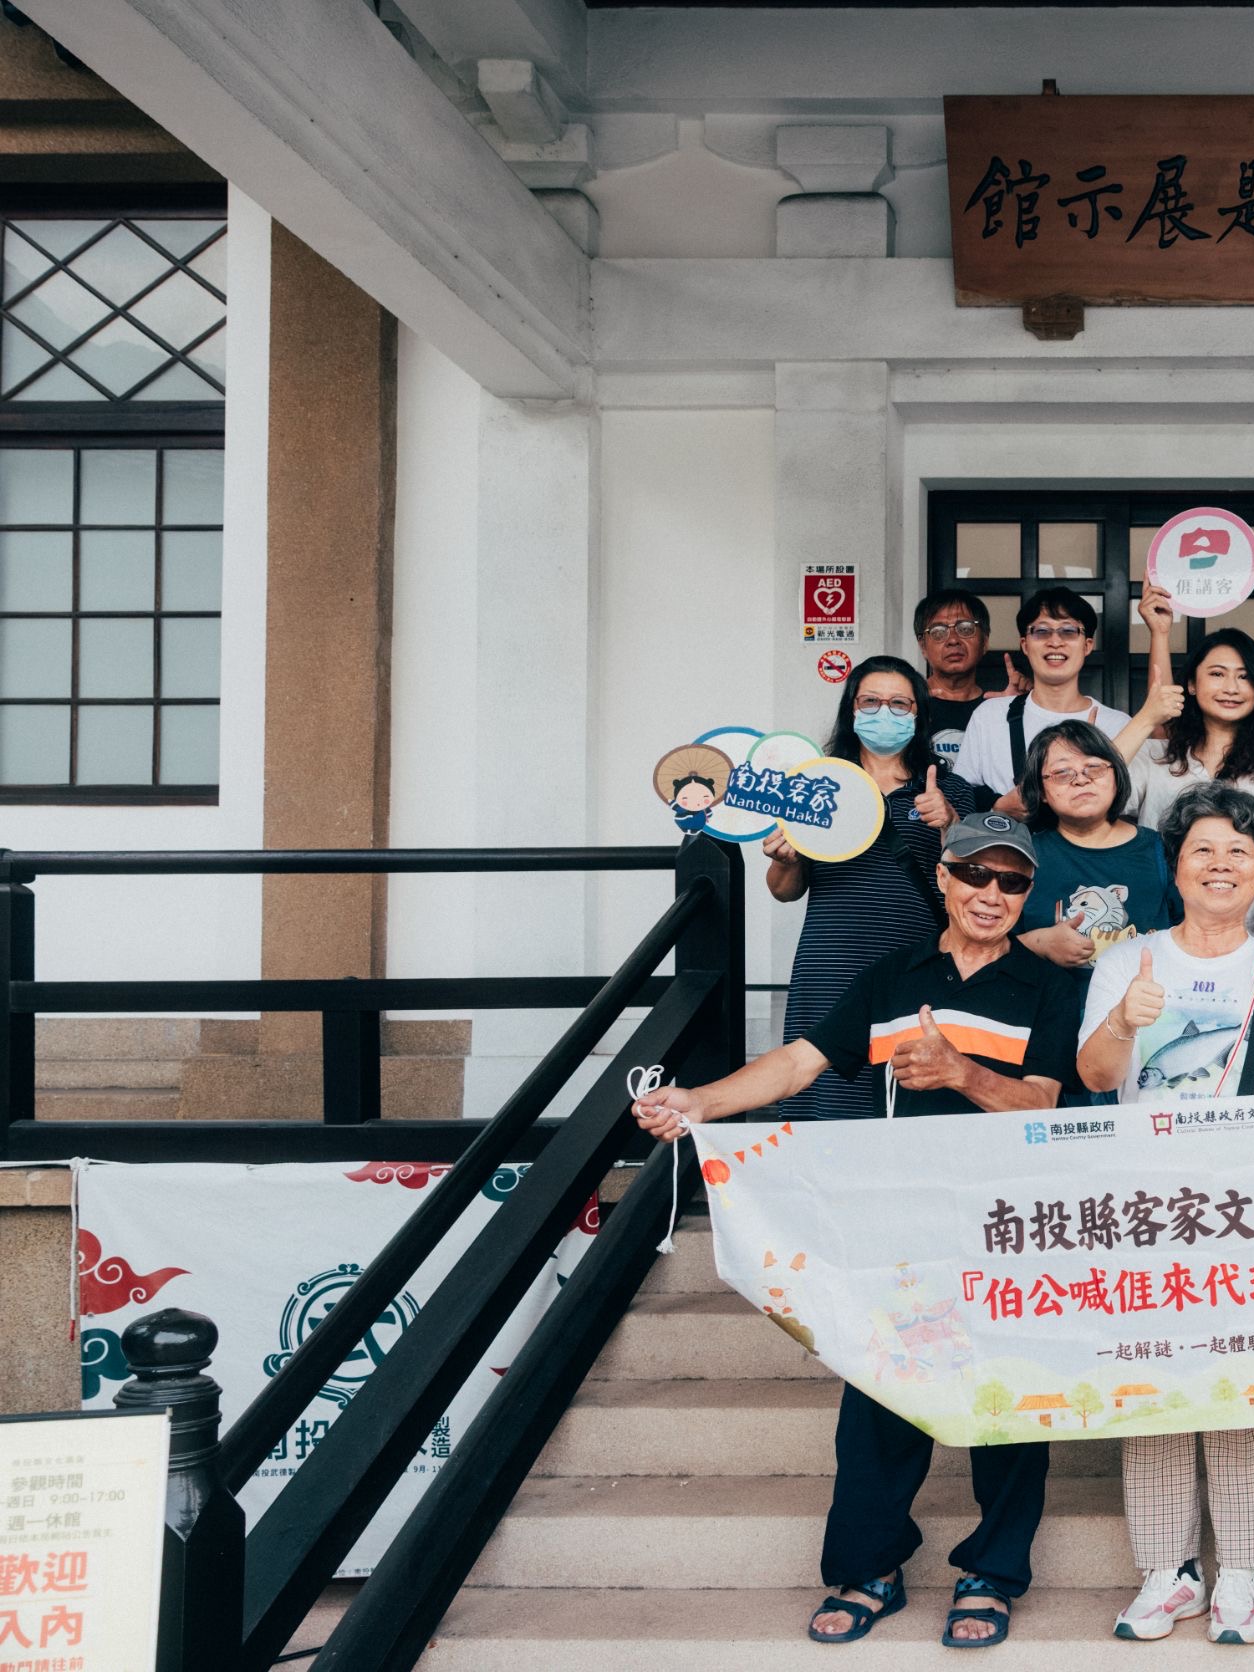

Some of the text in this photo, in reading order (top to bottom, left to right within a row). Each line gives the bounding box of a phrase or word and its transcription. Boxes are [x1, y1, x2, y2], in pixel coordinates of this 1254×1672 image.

[818, 578, 842, 588] AED
[935, 743, 961, 753] LUC
[728, 762, 838, 812] 南投客家
[725, 792, 830, 827] Nantou Hakka
[1192, 980, 1215, 993] 2023
[1050, 1120, 1115, 1135] 南投縣政府
[12, 1473, 84, 1492] 參觀時間
[8, 1512, 82, 1531] 週一休館
[0, 1551, 89, 1597] 歡迎
[0, 1605, 84, 1649] 入內
